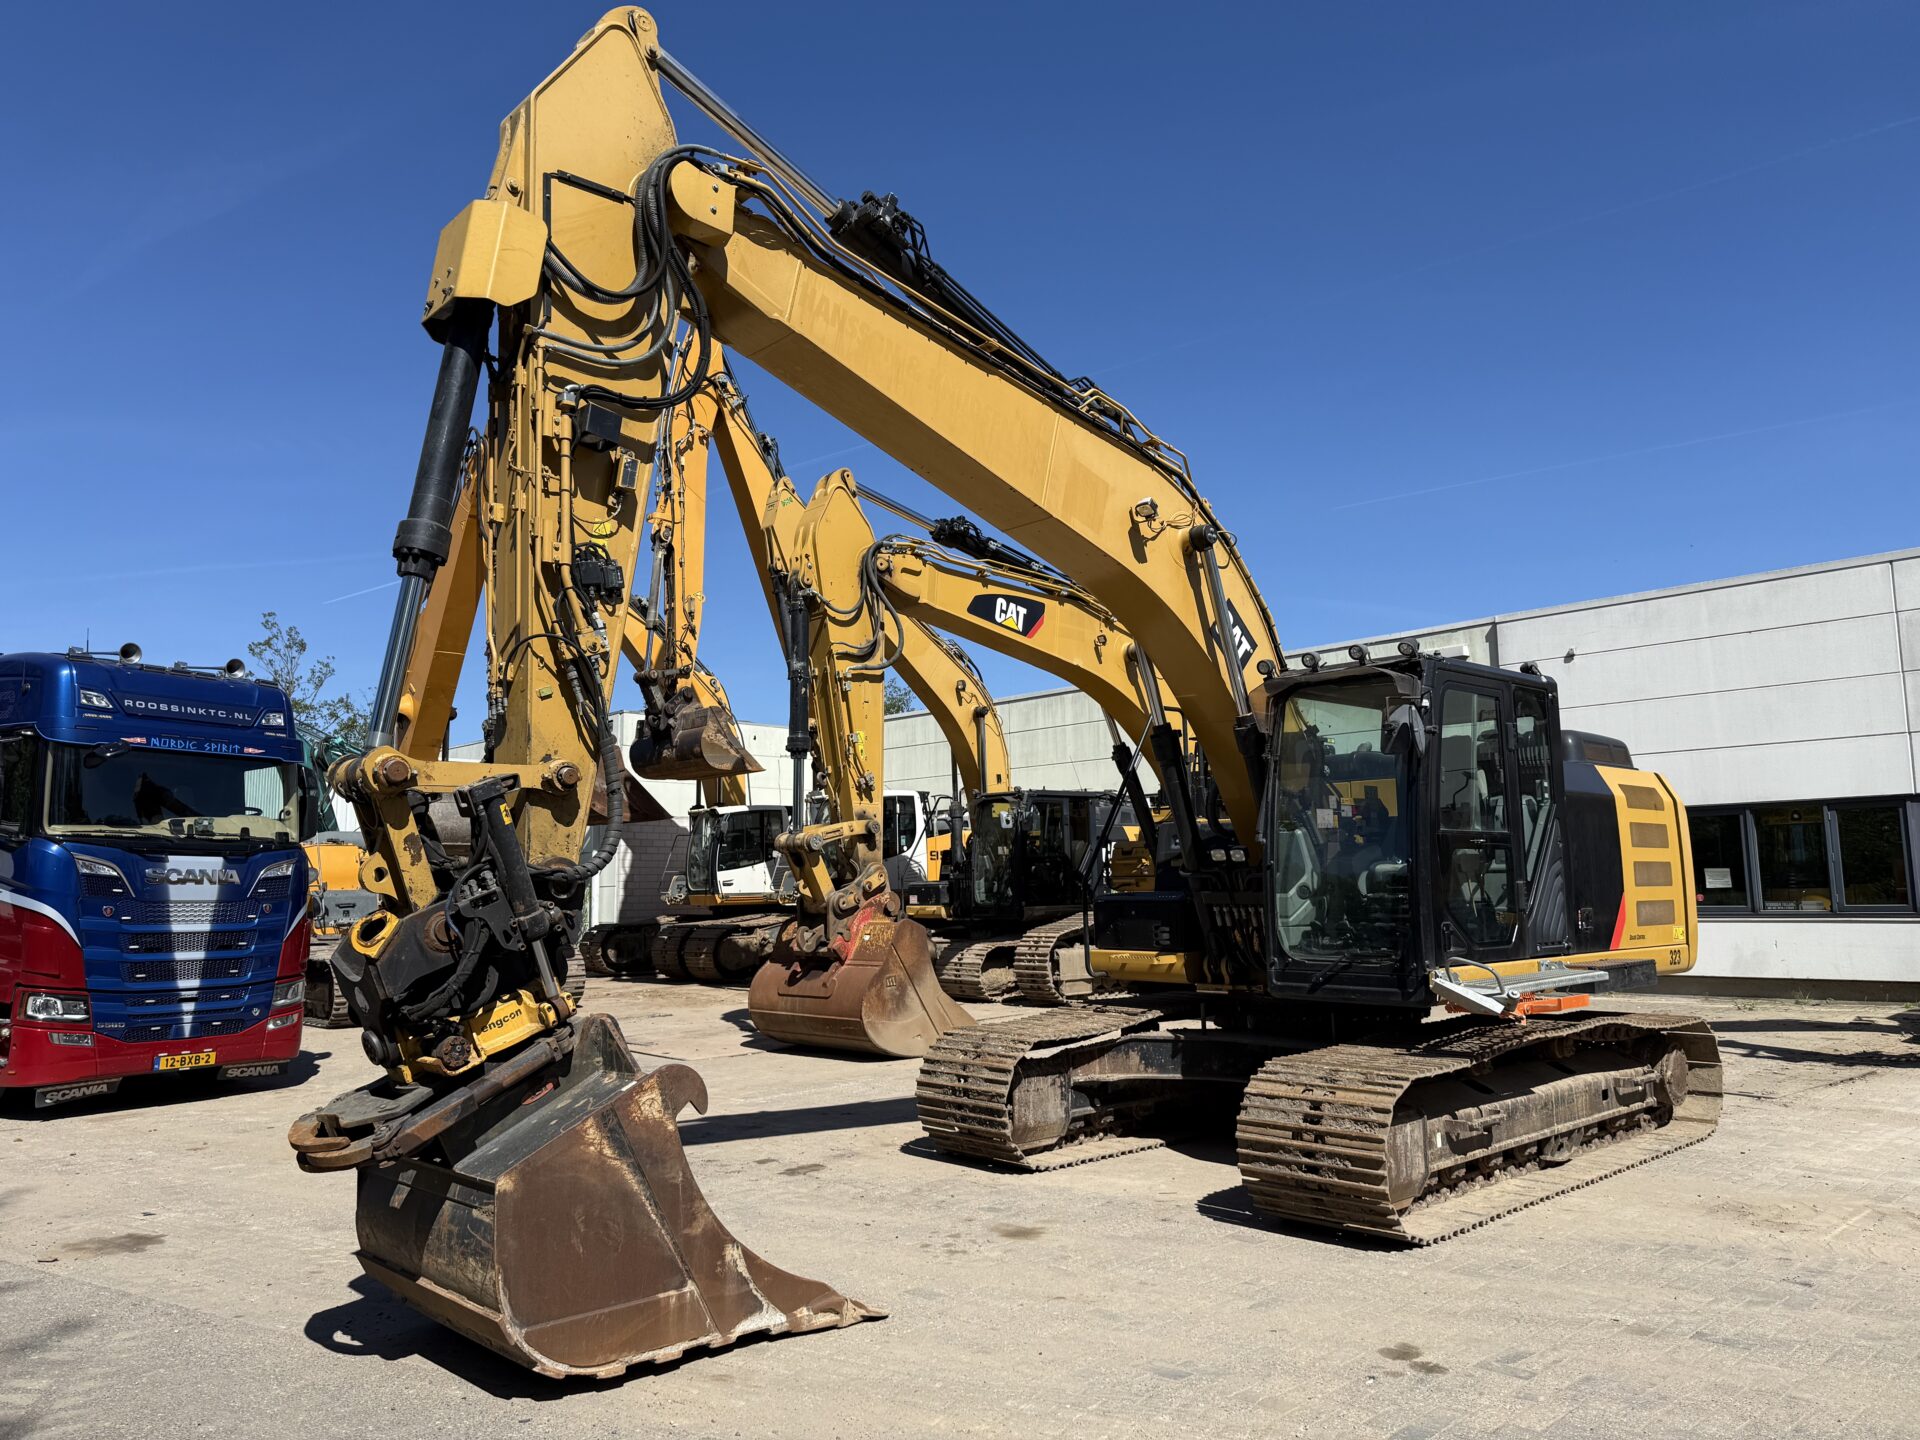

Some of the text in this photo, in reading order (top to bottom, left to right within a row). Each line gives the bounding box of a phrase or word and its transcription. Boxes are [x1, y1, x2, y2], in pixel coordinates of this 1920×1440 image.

[994, 597, 1027, 632] CAT
[124, 699, 252, 721] ROOSSINKTC.NL
[150, 737, 241, 754] NORDIC SPIRIT
[144, 867, 241, 885] SCANIA
[1669, 949, 1682, 966] 323
[481, 1007, 523, 1033] engcon
[165, 1053, 211, 1068] 12-BXB-2
[226, 1065, 280, 1078] SCANIA
[45, 1083, 108, 1104] SCANIA
